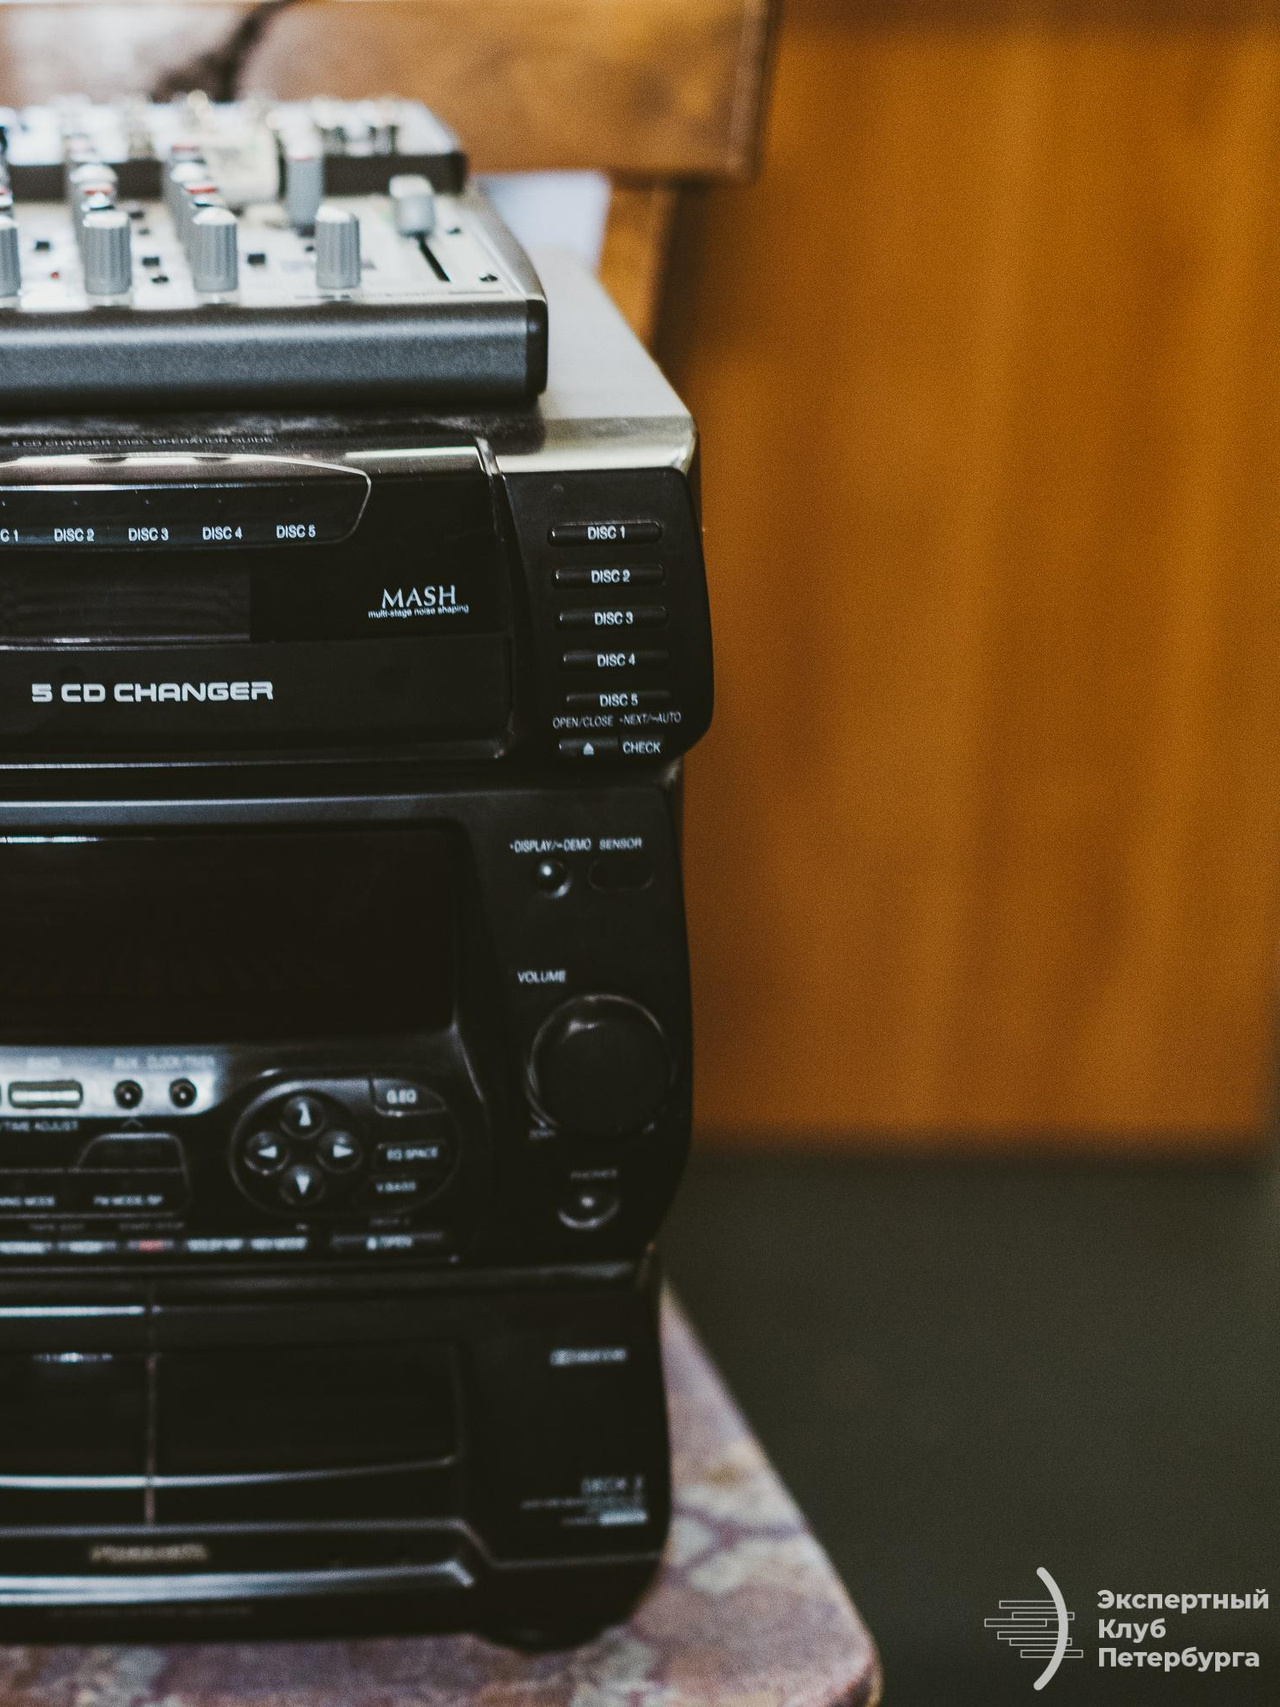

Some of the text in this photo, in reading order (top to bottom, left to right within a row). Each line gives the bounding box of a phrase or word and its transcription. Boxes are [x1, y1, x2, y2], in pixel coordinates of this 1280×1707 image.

[13, 528, 19, 542] 1
[54, 528, 95, 542] DISC 2
[128, 527, 169, 541] DISC 3
[202, 526, 243, 540] DISC 4
[276, 525, 316, 539] DISC 5
[587, 525, 626, 540] DISC 1
[591, 569, 631, 583] DISC 2
[381, 584, 456, 609] MASH
[368, 604, 470, 618] multi-stage noise shaping
[594, 611, 634, 625] DISC 3
[597, 653, 636, 667] DISC 4
[31, 681, 274, 702] 5 CD CHANGER
[600, 693, 638, 707] DISC 5
[552, 715, 614, 729] OPEN/CLOSE
[622, 741, 662, 754] CHECK
[599, 837, 643, 850] SENSOR
[517, 970, 567, 984] VOLUME
